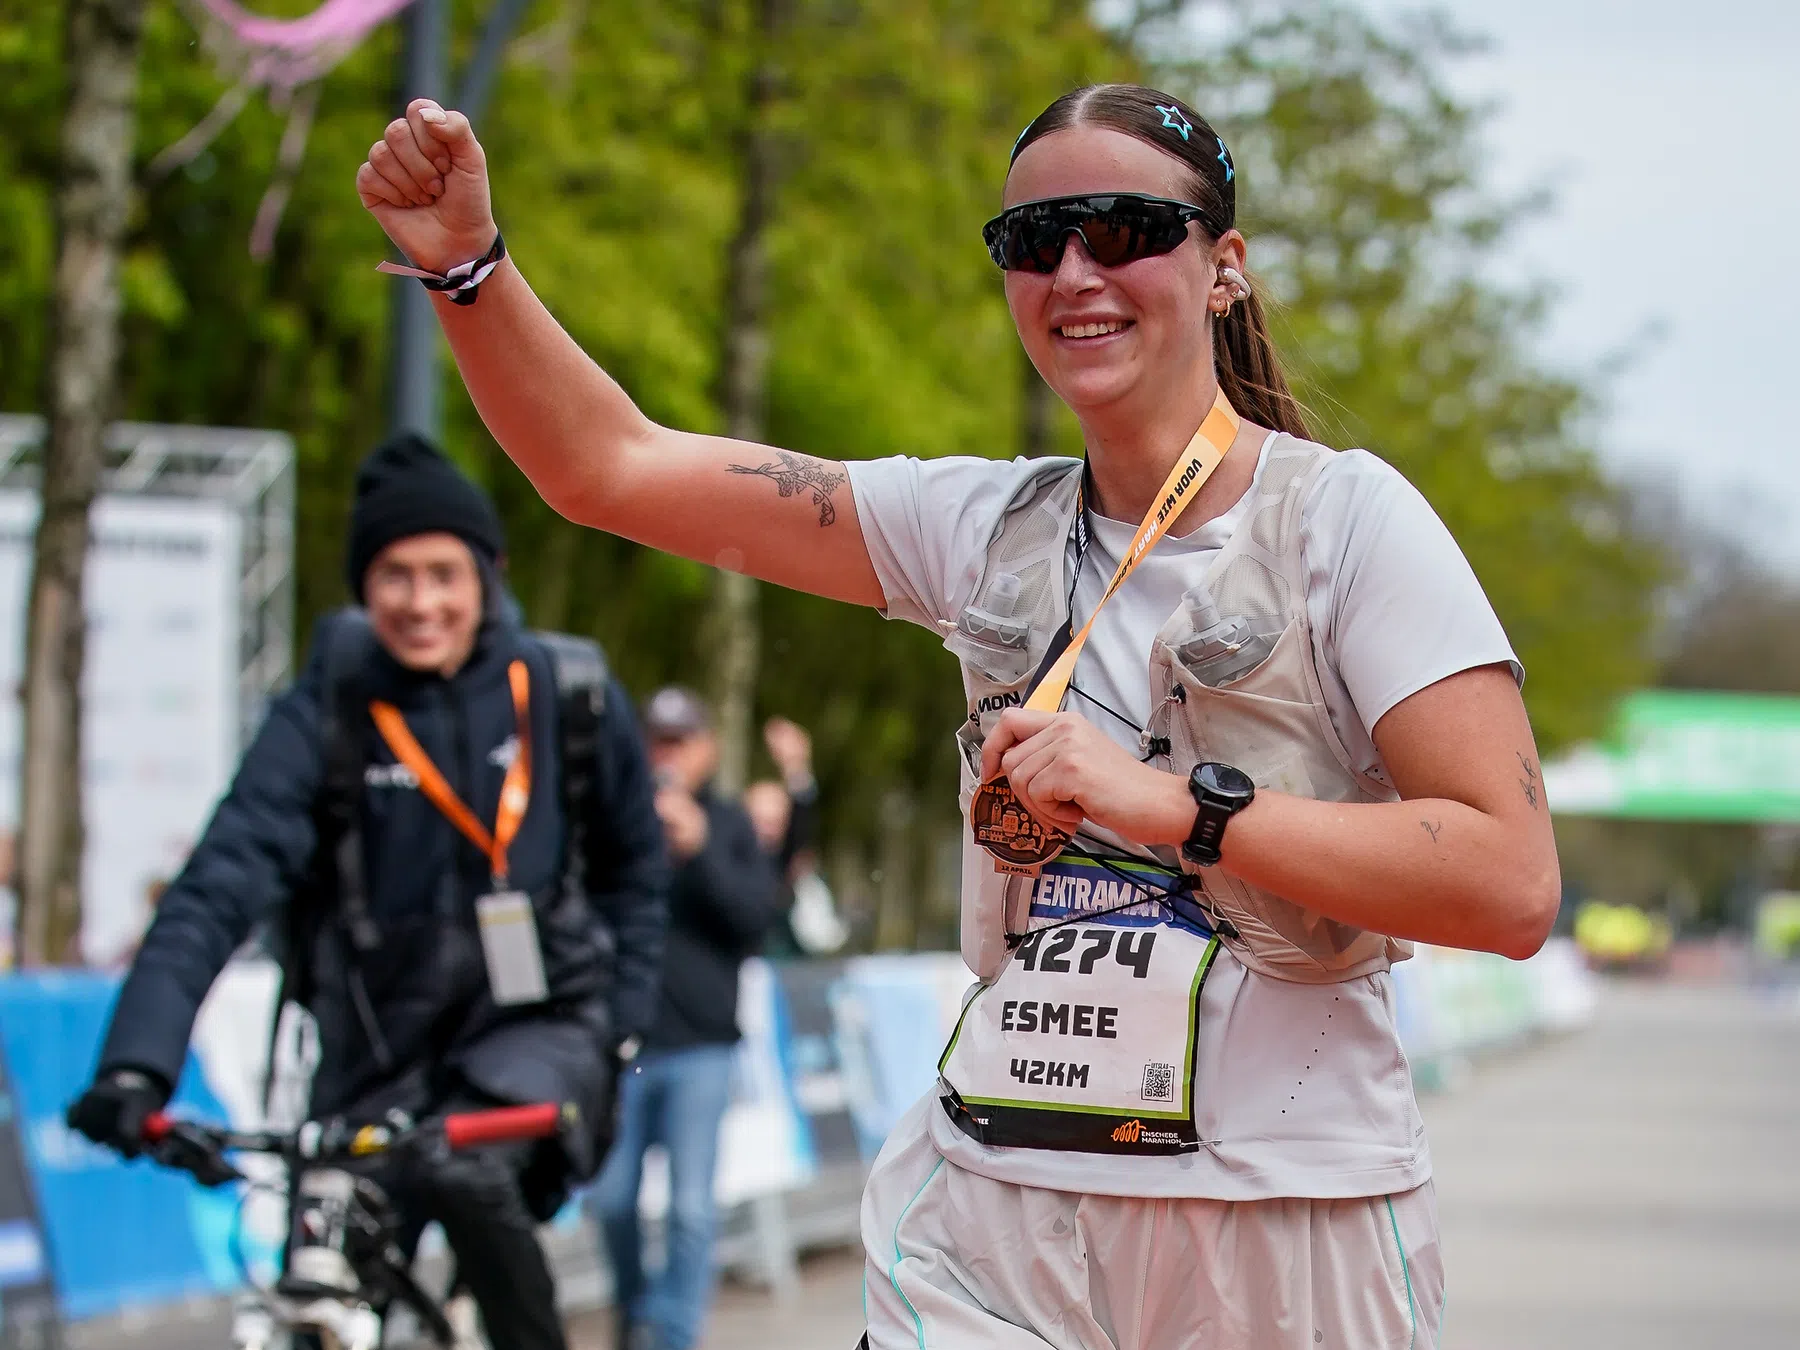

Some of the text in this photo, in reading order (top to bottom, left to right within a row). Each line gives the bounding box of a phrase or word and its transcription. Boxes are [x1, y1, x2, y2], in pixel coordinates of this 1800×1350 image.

[1174, 458, 1203, 497] VOOR
[1158, 493, 1177, 525] WIE
[1133, 519, 1158, 560] HART
[982, 785, 995, 794] 42
[1010, 866, 1033, 875] APRIL
[1014, 928, 1157, 979] 4274
[1001, 1001, 1119, 1039] ESMEE
[1010, 1058, 1090, 1089] 42KM
[1141, 1131, 1179, 1139] ENSCHEDE
[1141, 1137, 1182, 1145] MARATHON
